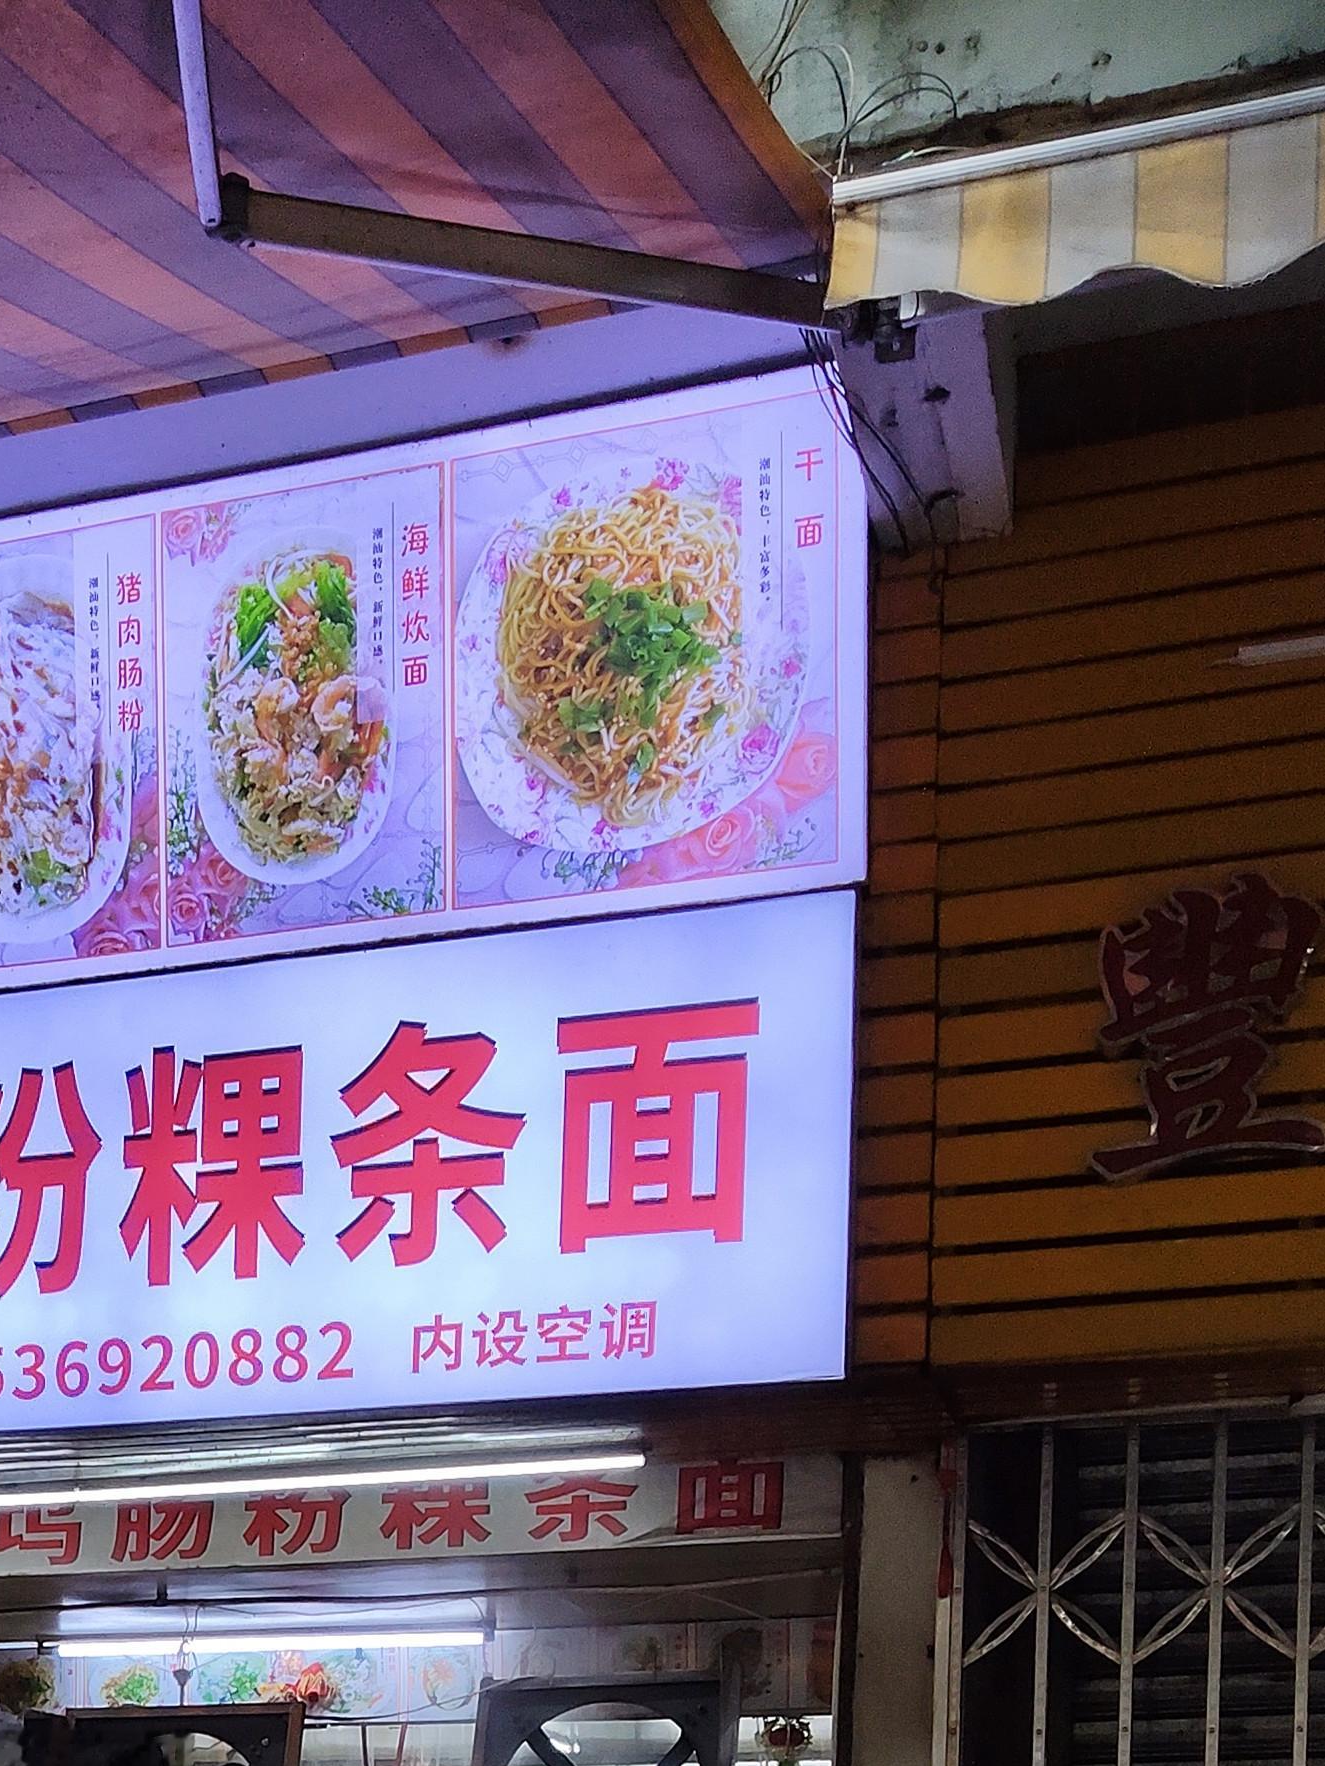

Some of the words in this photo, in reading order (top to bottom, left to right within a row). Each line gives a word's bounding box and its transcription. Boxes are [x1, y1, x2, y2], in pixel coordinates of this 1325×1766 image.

[794, 447, 824, 549] 干面
[116, 571, 144, 733] 猪肉肠粉
[401, 521, 429, 687] 海鲜炊面
[411, 1300, 658, 1374] 内设空调
